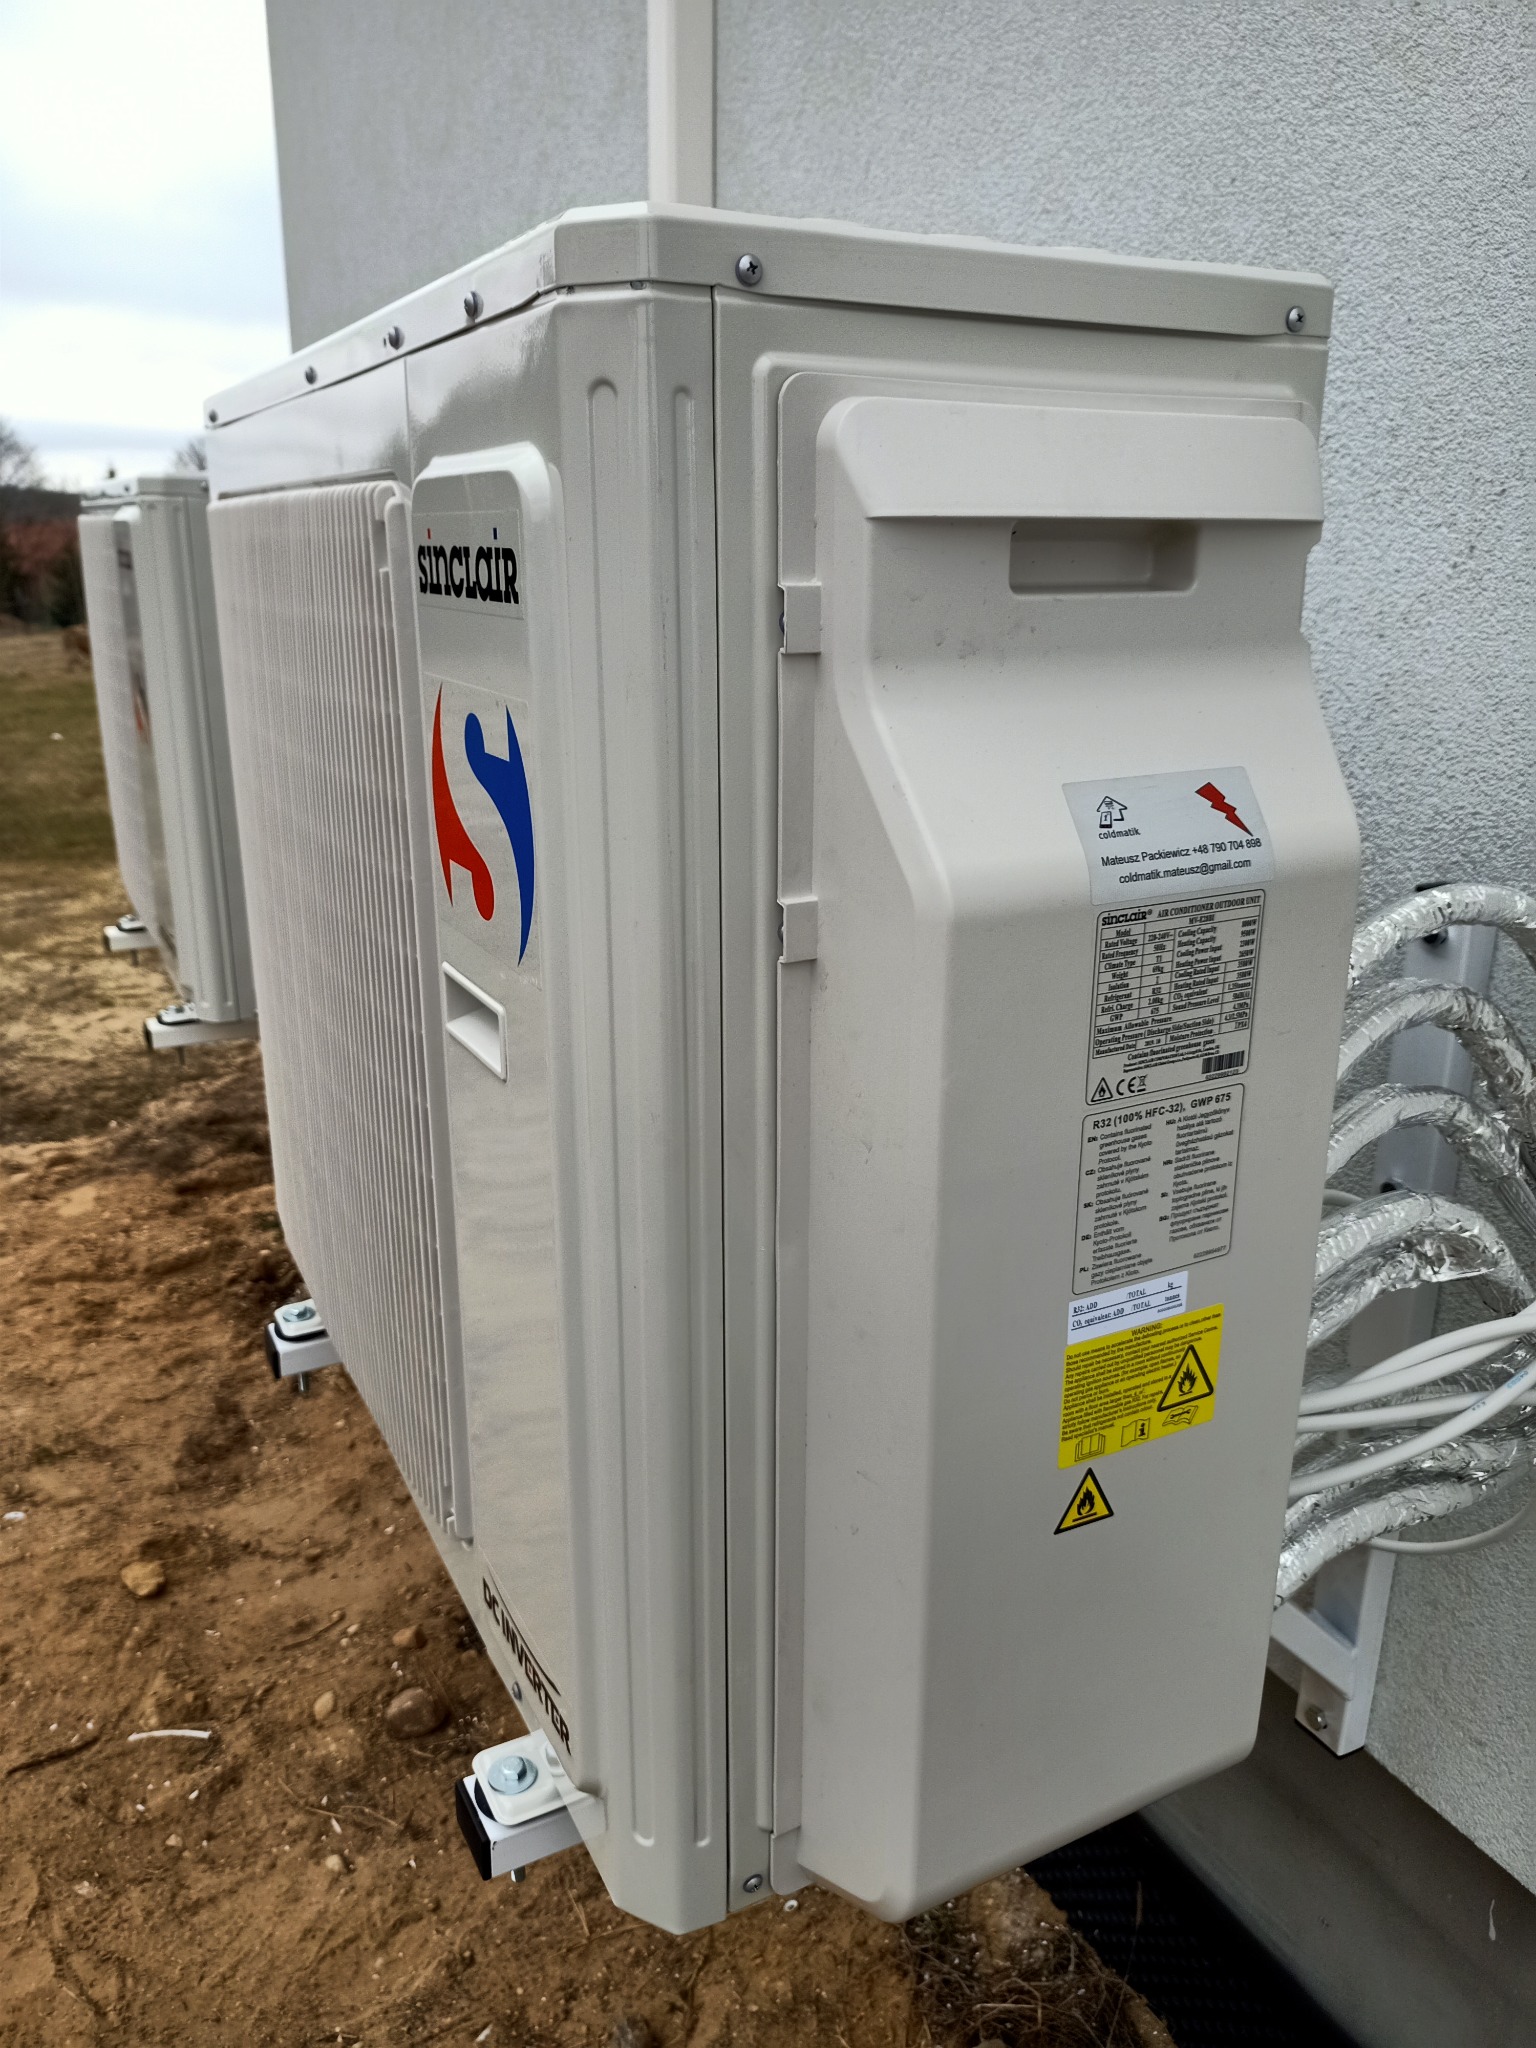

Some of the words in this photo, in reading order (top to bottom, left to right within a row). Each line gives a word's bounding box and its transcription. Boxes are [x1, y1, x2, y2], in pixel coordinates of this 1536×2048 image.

[1098, 827, 1141, 840] coldmatik
[1101, 852, 1140, 867] Mateusz
[1141, 847, 1190, 861] Packiewicz
[1191, 843, 1209, 855] +48
[1209, 841, 1227, 853] 790
[1228, 839, 1244, 851] 704
[1245, 837, 1262, 849] 898
[1119, 858, 1251, 884] coldmatik.mateusz@gmail.com
[1157, 909, 1169, 918] AIR
[1170, 902, 1214, 916] CONDITIONER
[1214, 898, 1245, 910] OUTDOOR
[1246, 895, 1261, 905] UNIT
[1116, 928, 1131, 937] Model
[1178, 928, 1196, 939] Cooling
[1196, 925, 1217, 936] Capacity
[1105, 940, 1119, 948] Rated
[1119, 937, 1138, 948] Voltage
[1177, 938, 1195, 949] Heating
[1195, 935, 1216, 946] Capacity
[1102, 952, 1115, 960] Rated
[1115, 947, 1138, 959] Frequency
[1176, 949, 1194, 959] Cooling
[1195, 946, 1210, 955] Power
[1210, 944, 1222, 954] Input
[1104, 961, 1124, 971] Climate
[1124, 959, 1136, 968] Type
[1175, 959, 1194, 970] Heating
[1194, 956, 1209, 965] Power
[1209, 954, 1221, 965] Input
[1112, 970, 1128, 981] Weight
[1175, 969, 1193, 980] Cooling
[1108, 981, 1129, 991] Isolation
[1174, 980, 1192, 991] Heating
[1104, 991, 1132, 1003] Refrigerant
[1172, 1002, 1188, 1011] Sound
[1188, 998, 1206, 1008] Pressure
[1206, 996, 1219, 1005] Level
[1115, 1001, 1133, 1012] Charge
[1097, 1024, 1122, 1035] Maximum
[1124, 1019, 1149, 1030] Allowable
[1151, 1015, 1172, 1025] Pressure
[1110, 1014, 1123, 1022] GWP
[1096, 1035, 1121, 1047] Operating
[1121, 1031, 1144, 1042] Pressure
[1169, 1032, 1190, 1042] Moisture
[1190, 1028, 1213, 1038] Protection
[1128, 1050, 1149, 1061] Contains
[1150, 1046, 1175, 1057] fluorinated
[1176, 1041, 1201, 1052] greenhouse
[1093, 1117, 1112, 1131] R32
[1114, 1111, 1142, 1127] (100%
[1191, 1095, 1214, 1109] GWP
[1215, 1091, 1231, 1104] 675
[1100, 1130, 1123, 1140] Contains
[1124, 1124, 1151, 1135] fluorinated
[1099, 1137, 1130, 1150] greenhouse
[1131, 1133, 1147, 1142] gases
[1099, 1147, 1119, 1157] covered
[1138, 1140, 1152, 1149] Kyoto
[482, 1576, 500, 1627] DC
[501, 1609, 572, 1757] INVERTER
